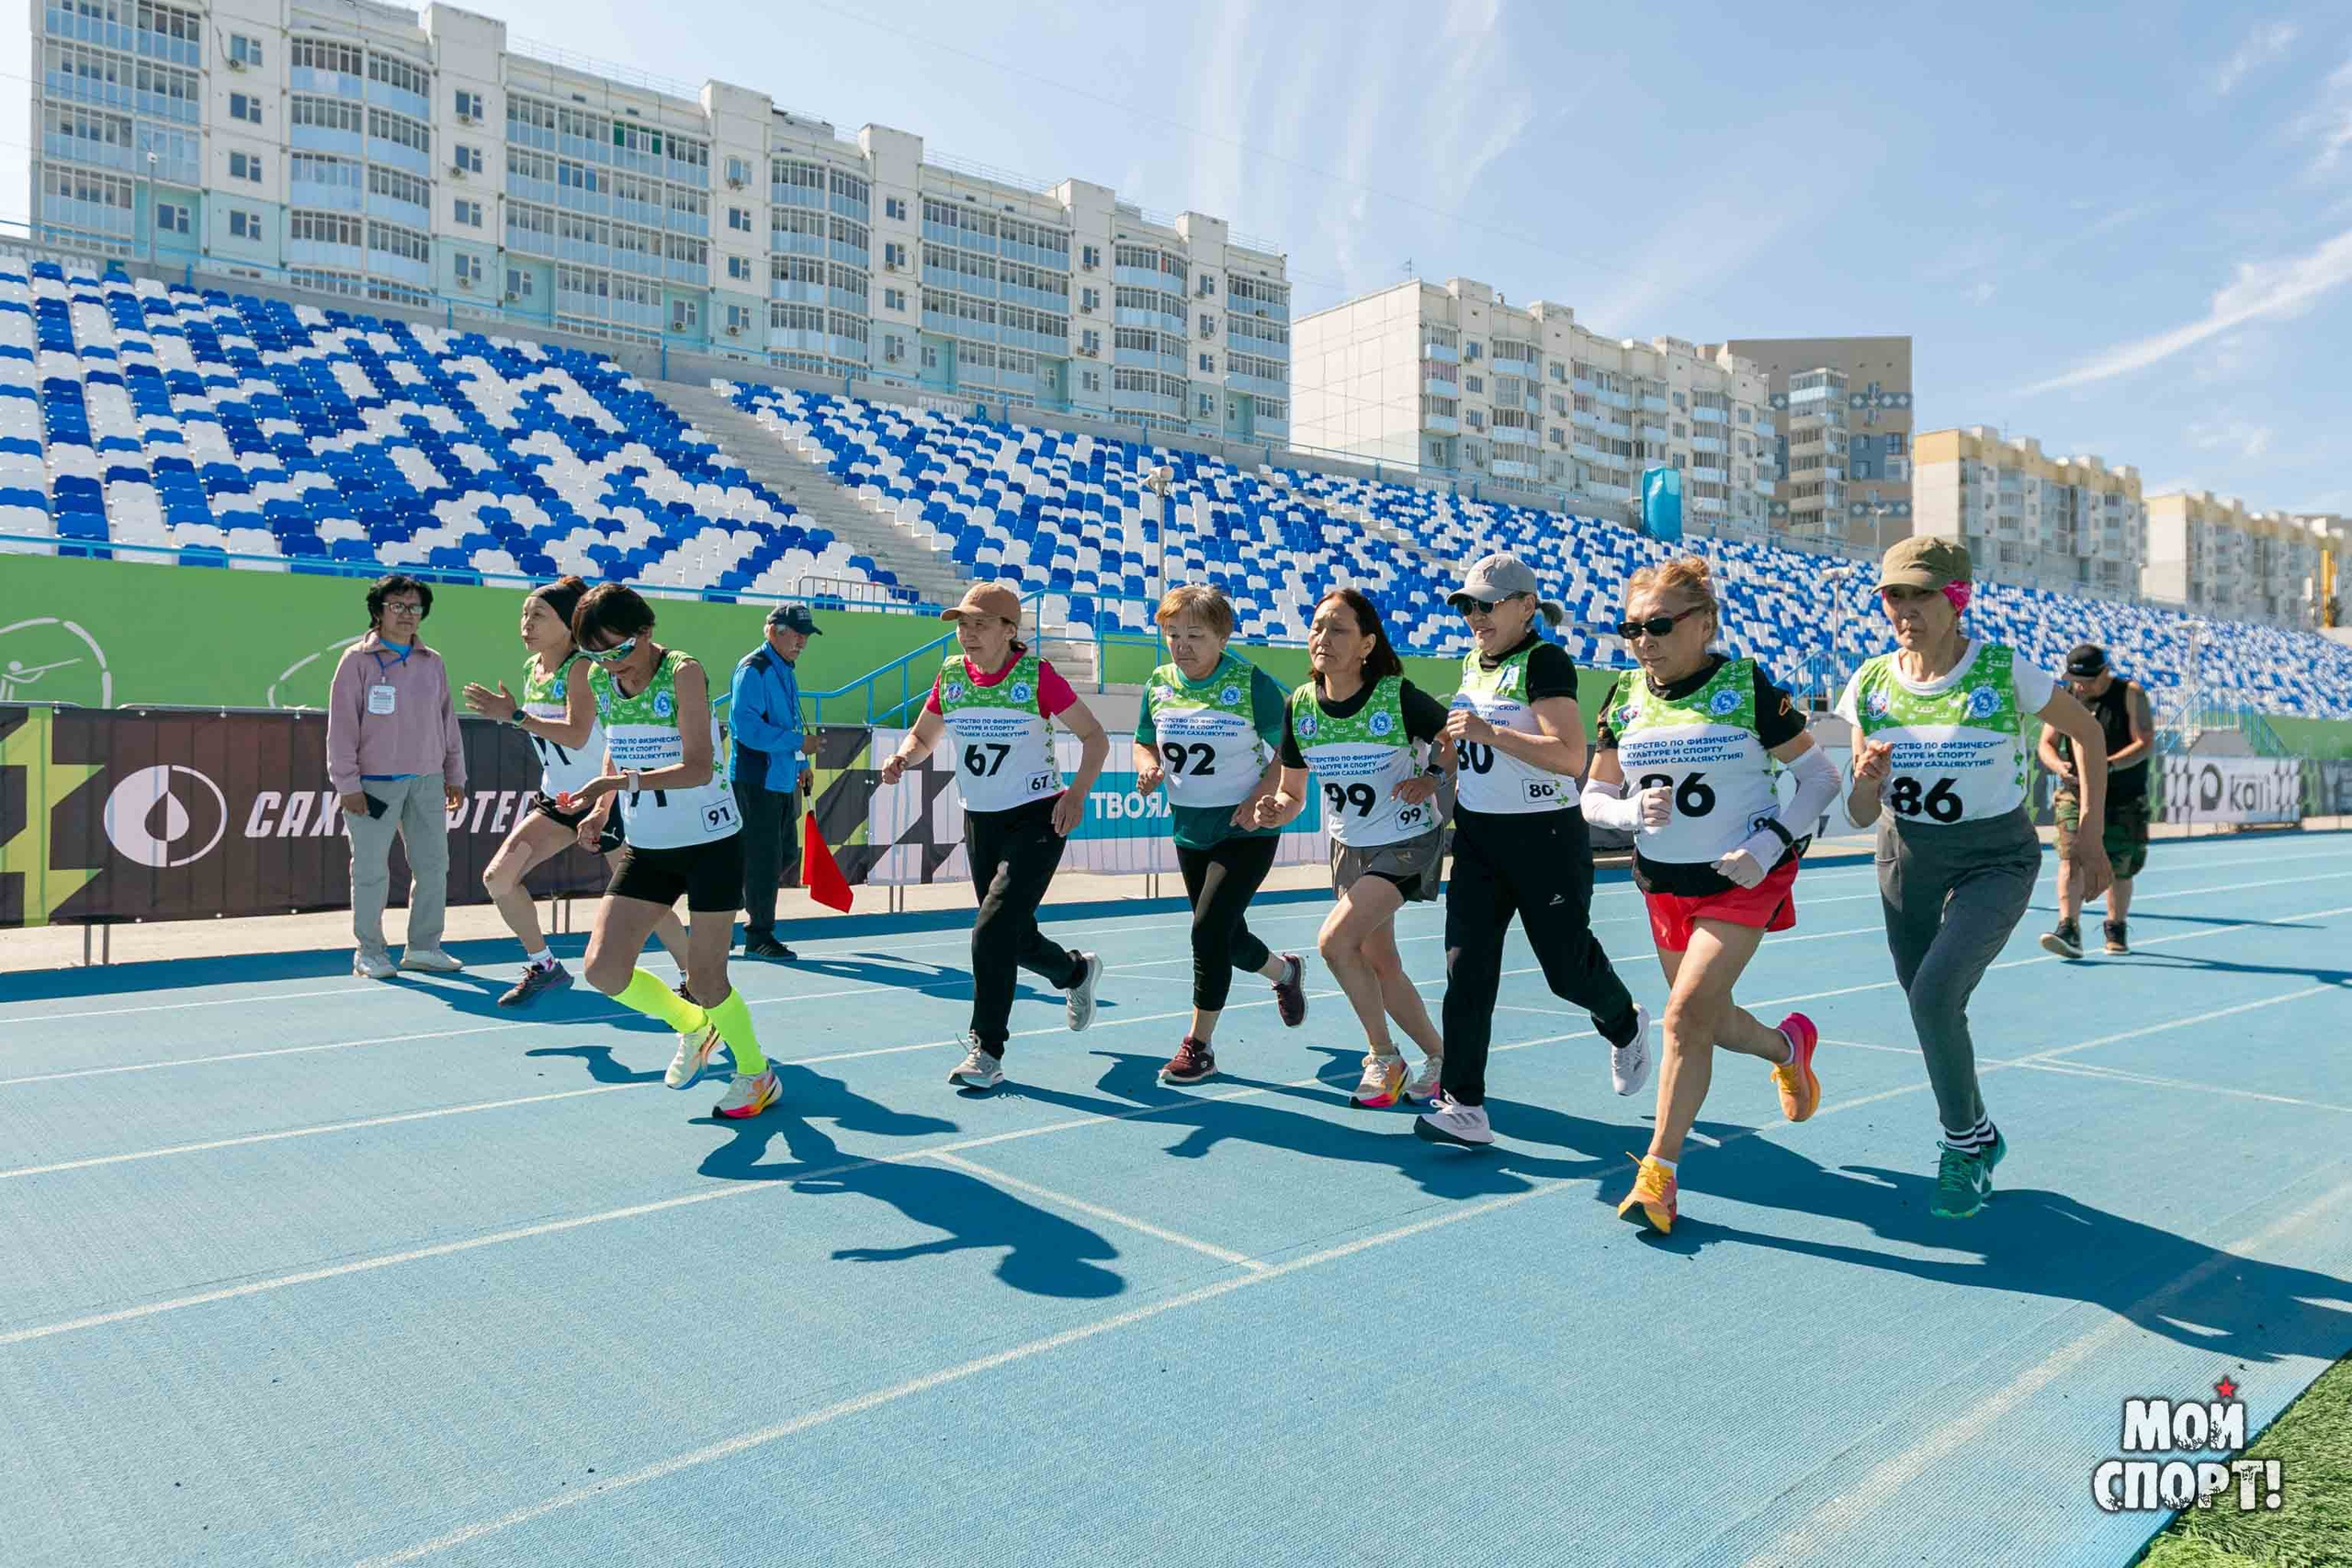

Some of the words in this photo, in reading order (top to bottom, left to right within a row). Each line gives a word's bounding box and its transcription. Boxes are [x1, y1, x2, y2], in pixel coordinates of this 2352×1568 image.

[639, 735, 682, 744] ФИЗИЧЕСКО
[1669, 739, 1683, 747] ПО
[964, 743, 1012, 777] 67
[1161, 741, 1216, 776] 92
[1627, 749, 1672, 760] КУЛЬТУРЕ
[1682, 745, 1724, 755] СПОРТУ
[1031, 775, 1049, 791] 67
[1529, 784, 1554, 798] 80
[1324, 783, 1376, 818] 99
[1891, 776, 1963, 823] 86
[707, 807, 730, 826] 91
[1400, 807, 1421, 825] 99
